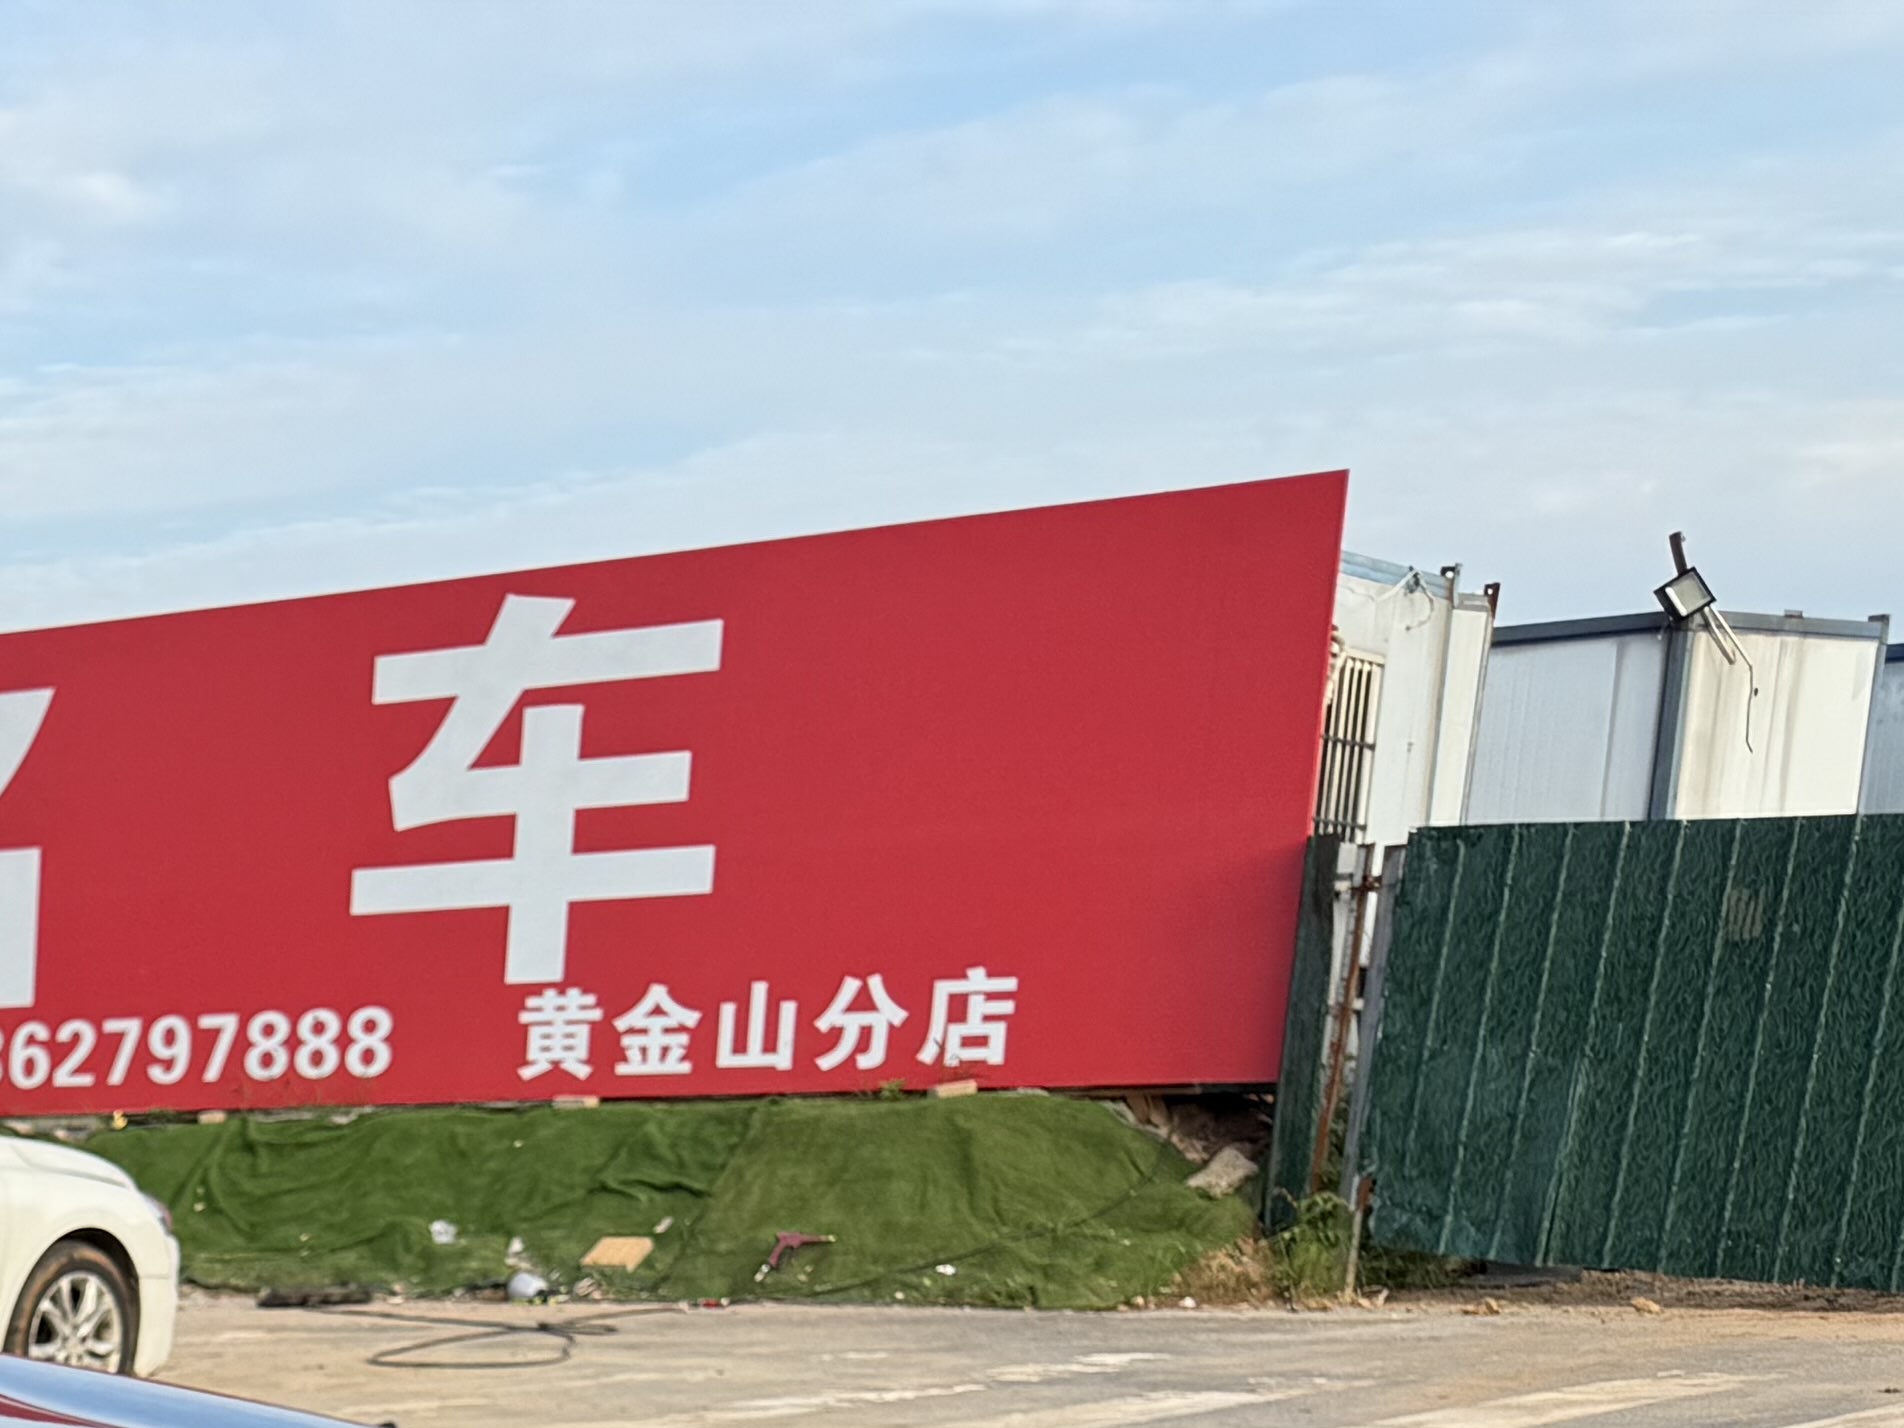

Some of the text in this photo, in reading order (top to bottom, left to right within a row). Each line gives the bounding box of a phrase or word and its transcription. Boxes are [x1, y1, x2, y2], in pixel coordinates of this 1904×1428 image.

[517, 965, 1019, 1081] 黄金山分店
